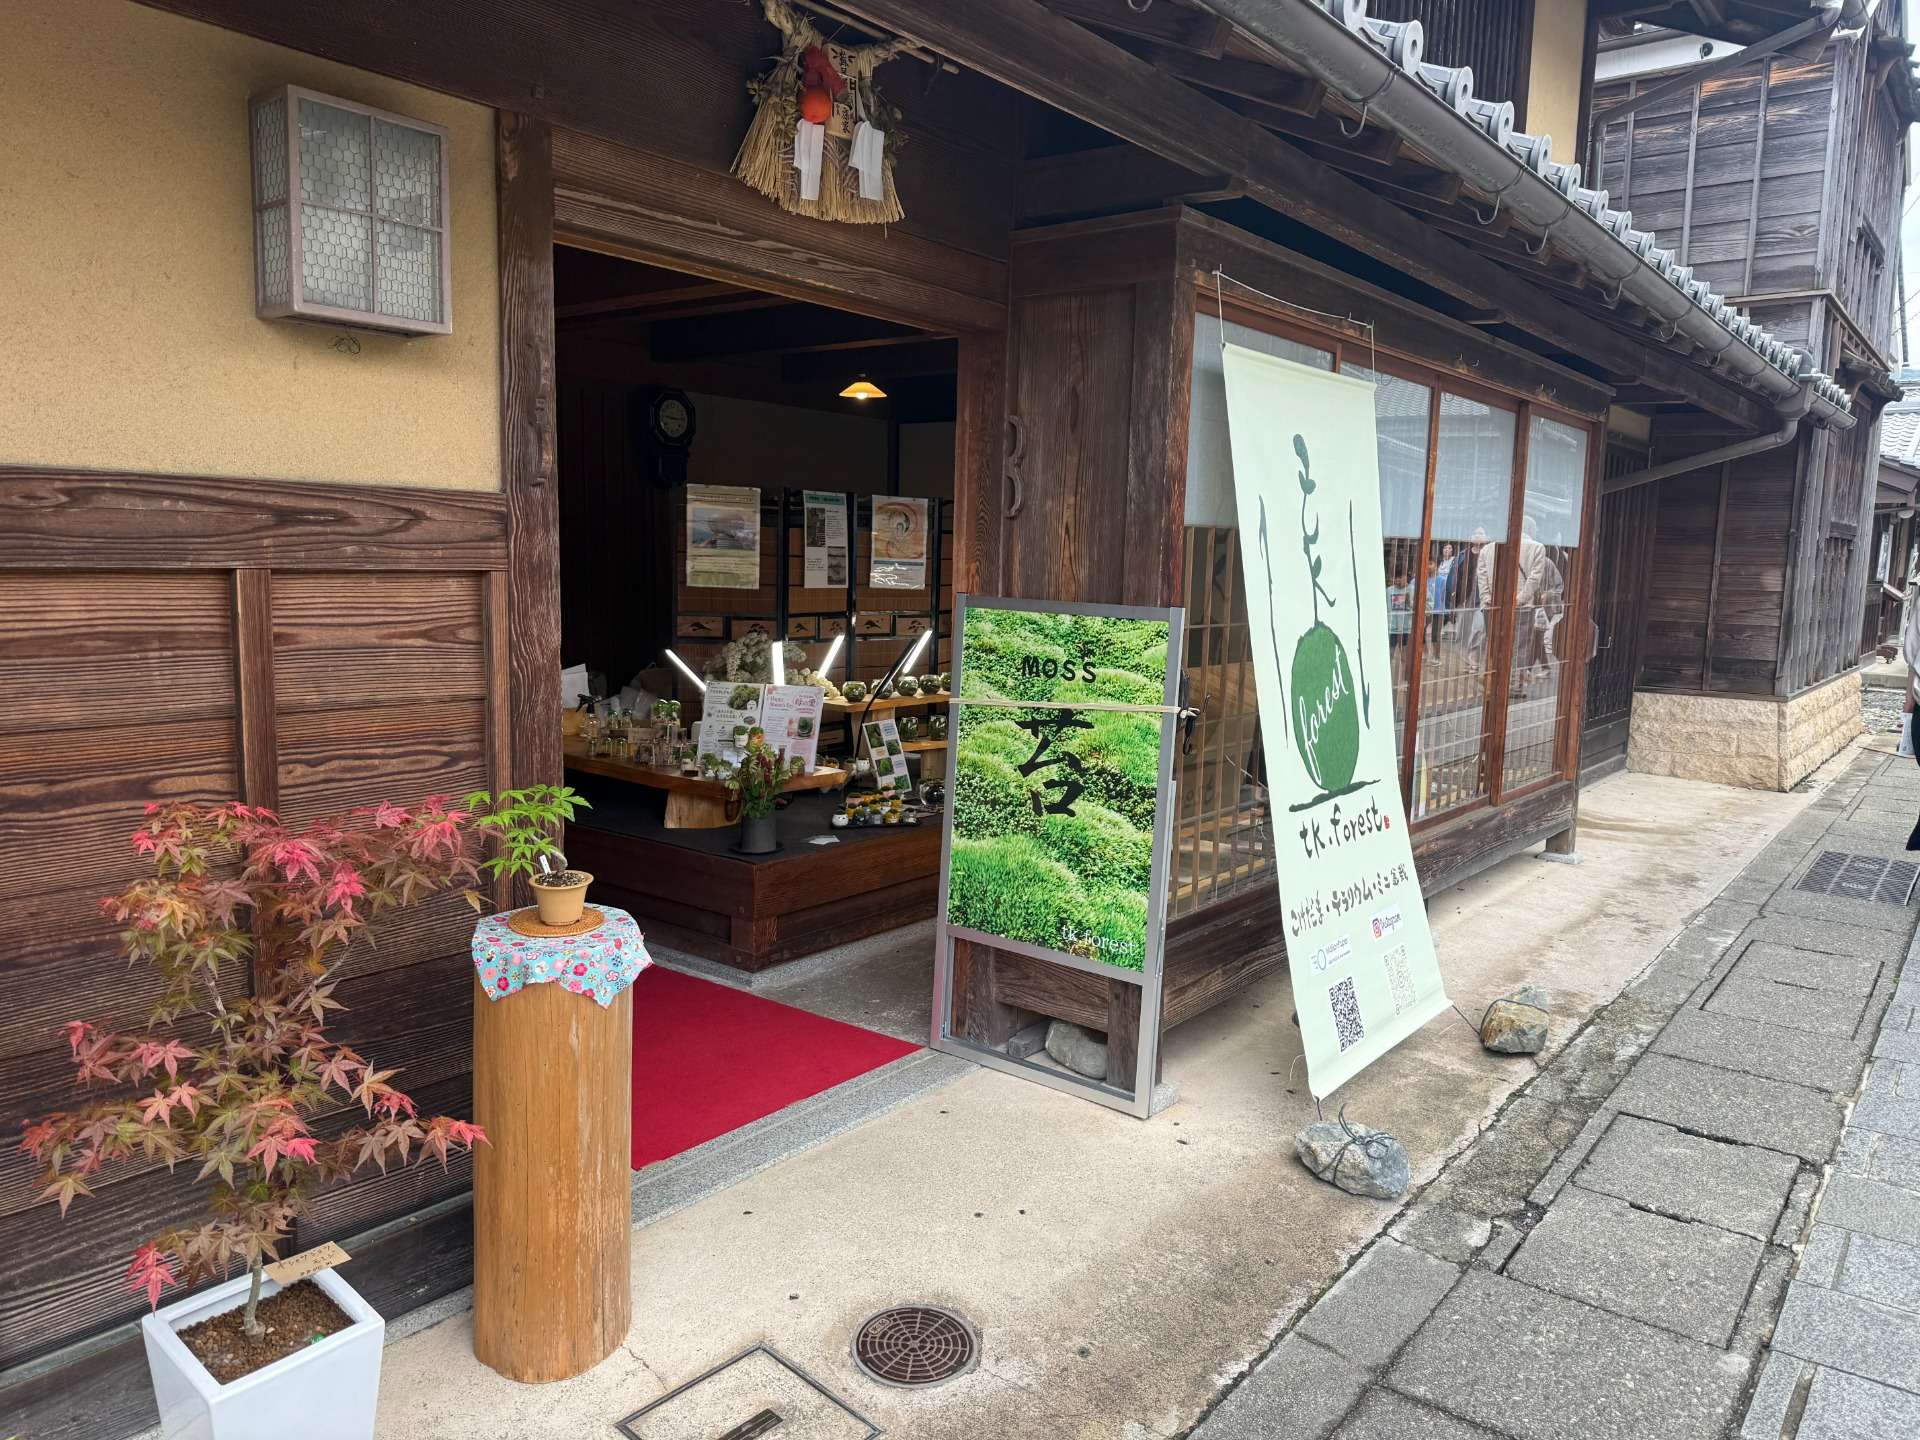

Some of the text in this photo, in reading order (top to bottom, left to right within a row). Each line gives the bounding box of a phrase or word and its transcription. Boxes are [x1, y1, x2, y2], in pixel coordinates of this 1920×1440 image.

[1022, 654, 1097, 684] MOSS
[1299, 643, 1349, 786] forest
[1014, 707, 1095, 818] 苔
